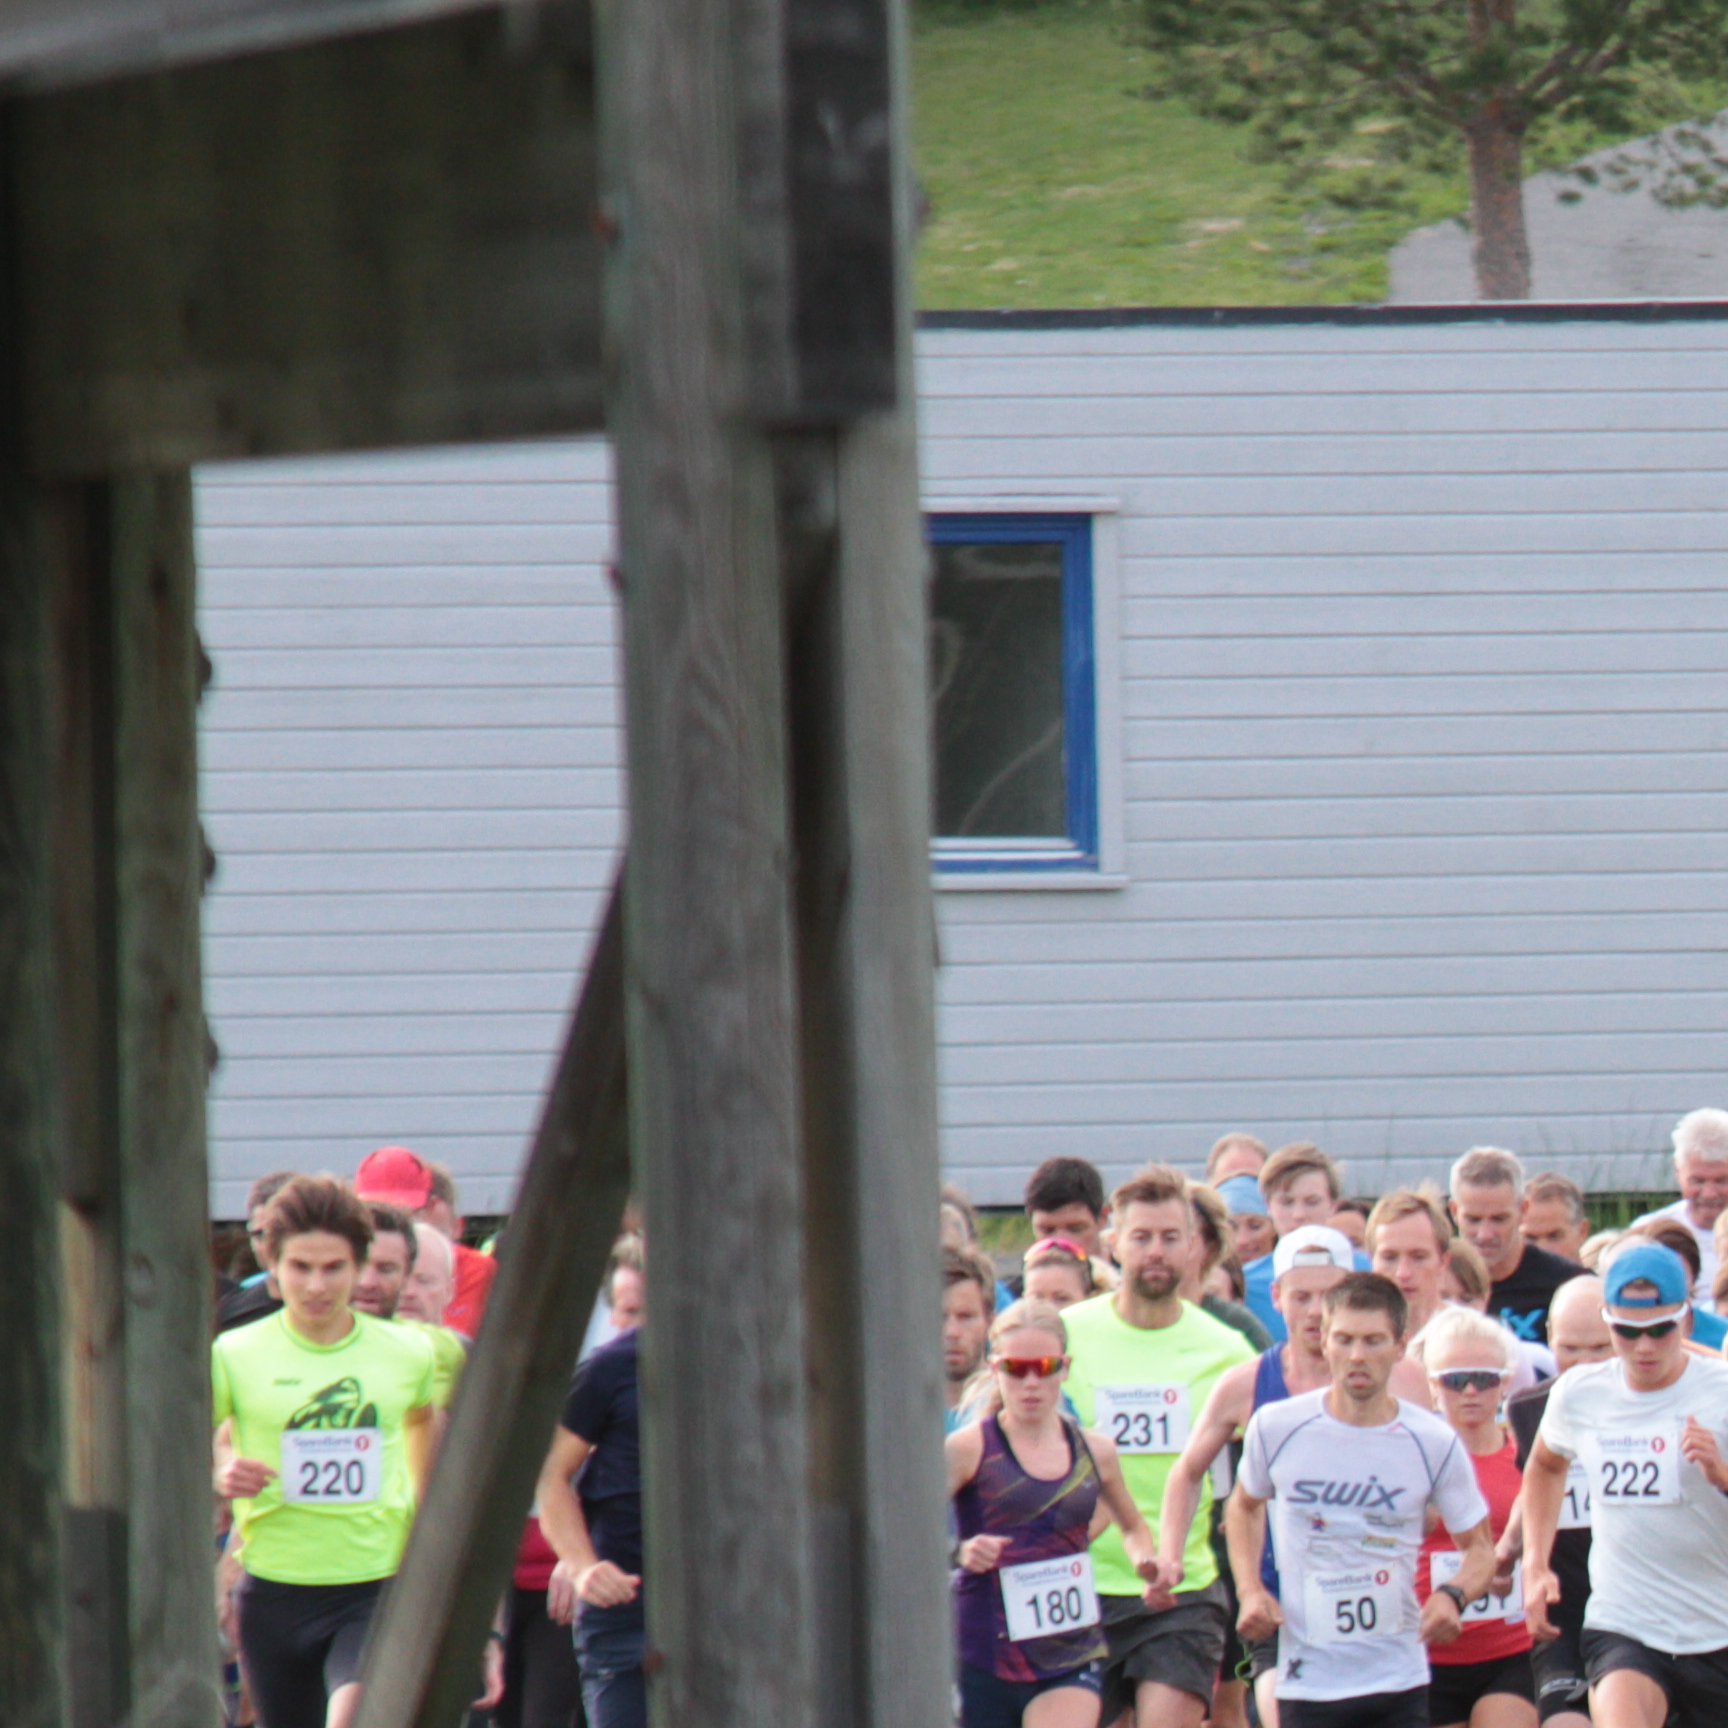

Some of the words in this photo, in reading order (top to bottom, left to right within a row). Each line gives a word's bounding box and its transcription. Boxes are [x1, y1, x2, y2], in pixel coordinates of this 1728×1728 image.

[1112, 1412, 1168, 1447] 231
[299, 1459, 364, 1496] 220
[1601, 1461, 1660, 1497] 222
[1026, 1586, 1082, 1629] 180
[1336, 1596, 1377, 1634] 50
